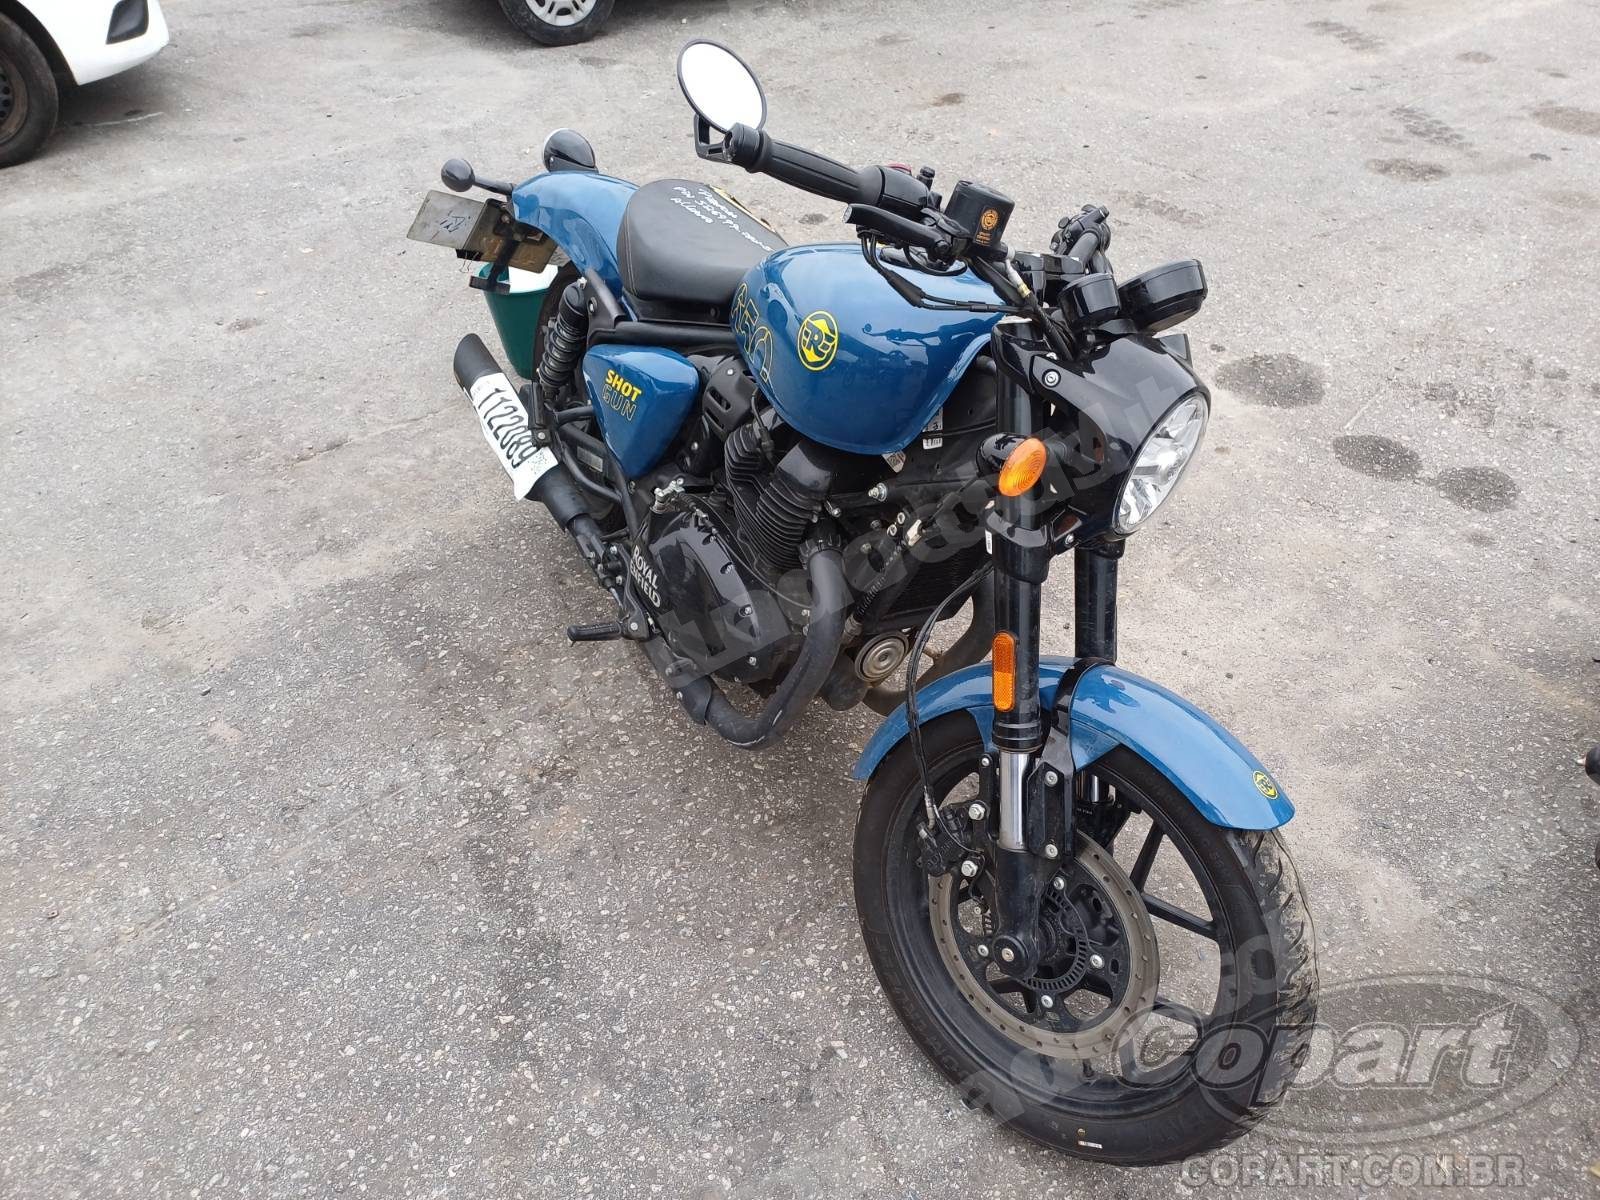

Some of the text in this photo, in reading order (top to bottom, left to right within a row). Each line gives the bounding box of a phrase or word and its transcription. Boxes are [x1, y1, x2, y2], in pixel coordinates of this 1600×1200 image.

[602, 383, 637, 421] GUN
[605, 369, 642, 402] SHOT
[477, 387, 541, 469] 1122089
[629, 559, 661, 608] ENFIELD
[632, 544, 658, 590] ROYAL
